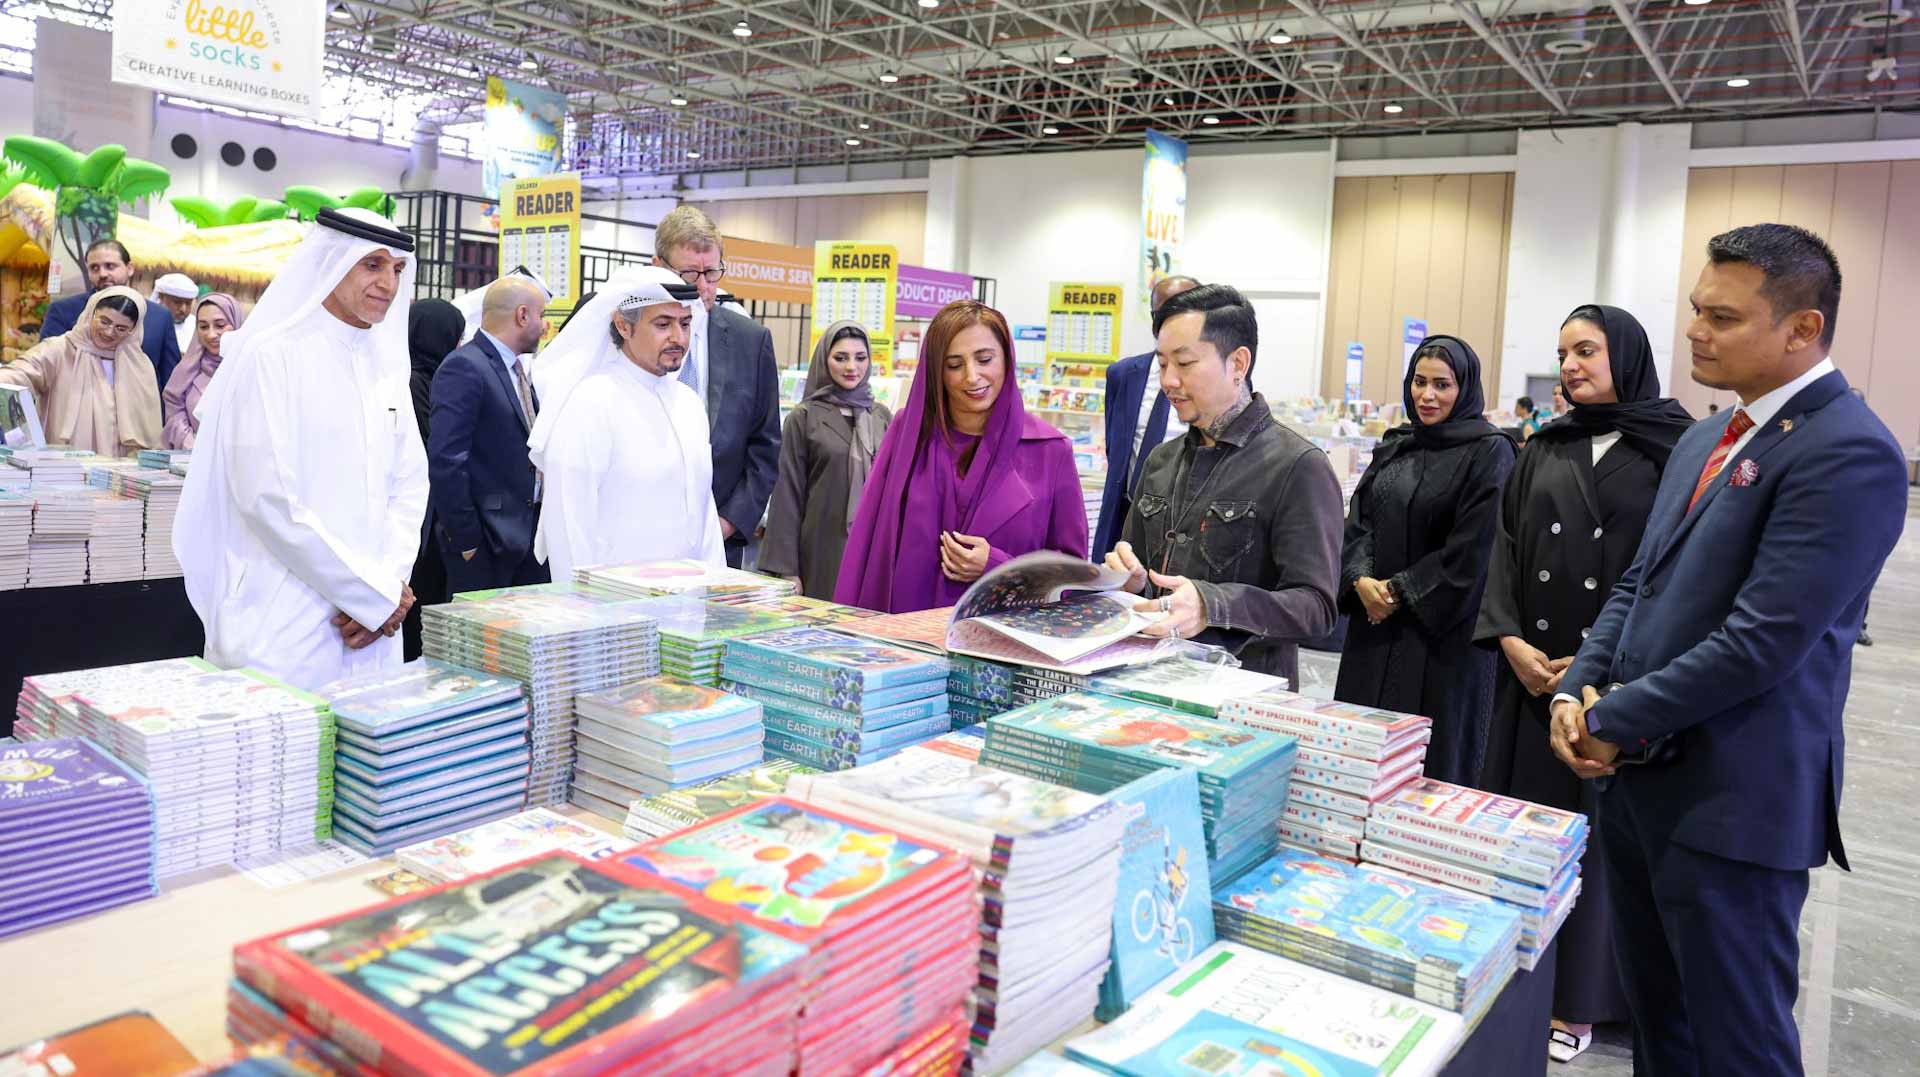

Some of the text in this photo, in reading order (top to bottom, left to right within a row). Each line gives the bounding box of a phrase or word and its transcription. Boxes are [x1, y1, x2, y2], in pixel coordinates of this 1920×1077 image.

[185, 0, 269, 48] little
[189, 40, 261, 71] socks
[127, 59, 310, 106] CREATIVE LEARNING BOXES
[517, 191, 574, 216] READER
[832, 253, 891, 269] READER
[1064, 292, 1117, 305] READER
[787, 661, 823, 679] EARTH
[1034, 669, 1043, 677] THE
[1044, 671, 1069, 684] EARTH
[784, 681, 820, 699] EARTH
[1023, 688, 1035, 697] THE
[1026, 679, 1037, 688] THE
[1038, 680, 1064, 693] EARTH
[815, 708, 853, 726] EARTH
[1302, 719, 1319, 728] PACK
[786, 720, 821, 738] EARTH
[783, 740, 817, 758] EARTH
[1396, 815, 1407, 823] MY
[1410, 817, 1437, 830] HUMAN
[1480, 836, 1498, 847] PACK
[1387, 829, 1399, 837] MY
[1401, 832, 1428, 846] HUMAN
[1469, 851, 1489, 863] PACK
[1463, 875, 1482, 886] PACK
[357, 926, 521, 1008] ALL
[418, 902, 681, 1050] ACCESS
